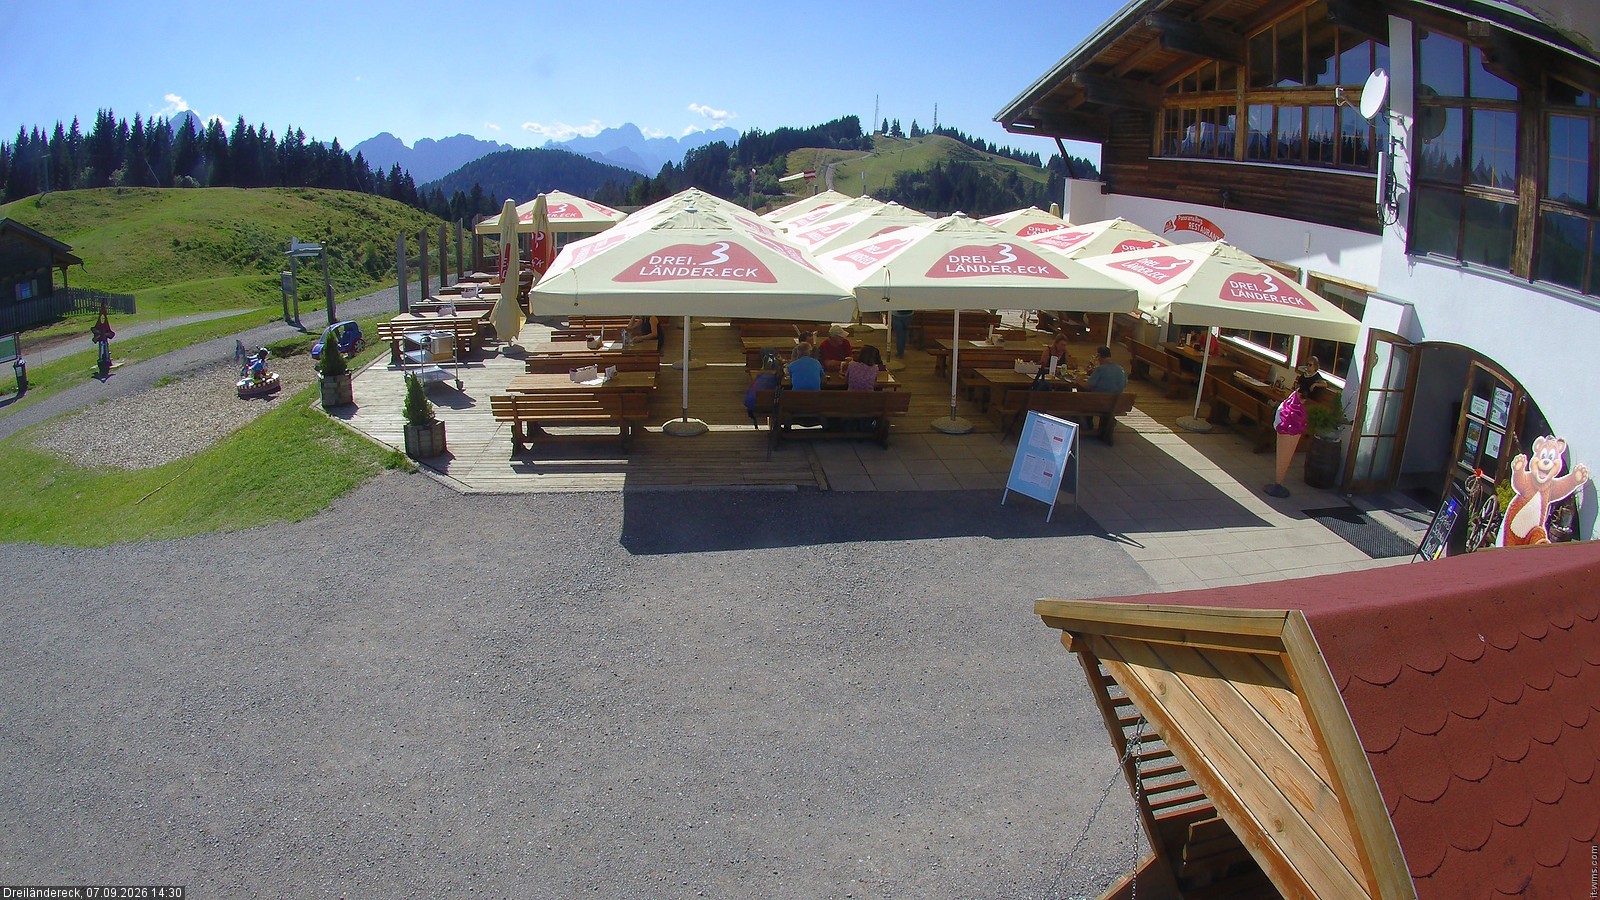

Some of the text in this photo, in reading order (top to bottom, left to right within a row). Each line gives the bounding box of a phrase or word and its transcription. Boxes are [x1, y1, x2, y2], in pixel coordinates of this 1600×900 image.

[649, 255, 696, 265] DREI.
[948, 254, 992, 264] DREI.
[639, 264, 759, 277] LÄNDER.ECK
[945, 262, 1050, 274] LÄNDER.ECK
[1229, 280, 1262, 292] DREI.
[1230, 288, 1305, 306] LÄNDER.ECK
